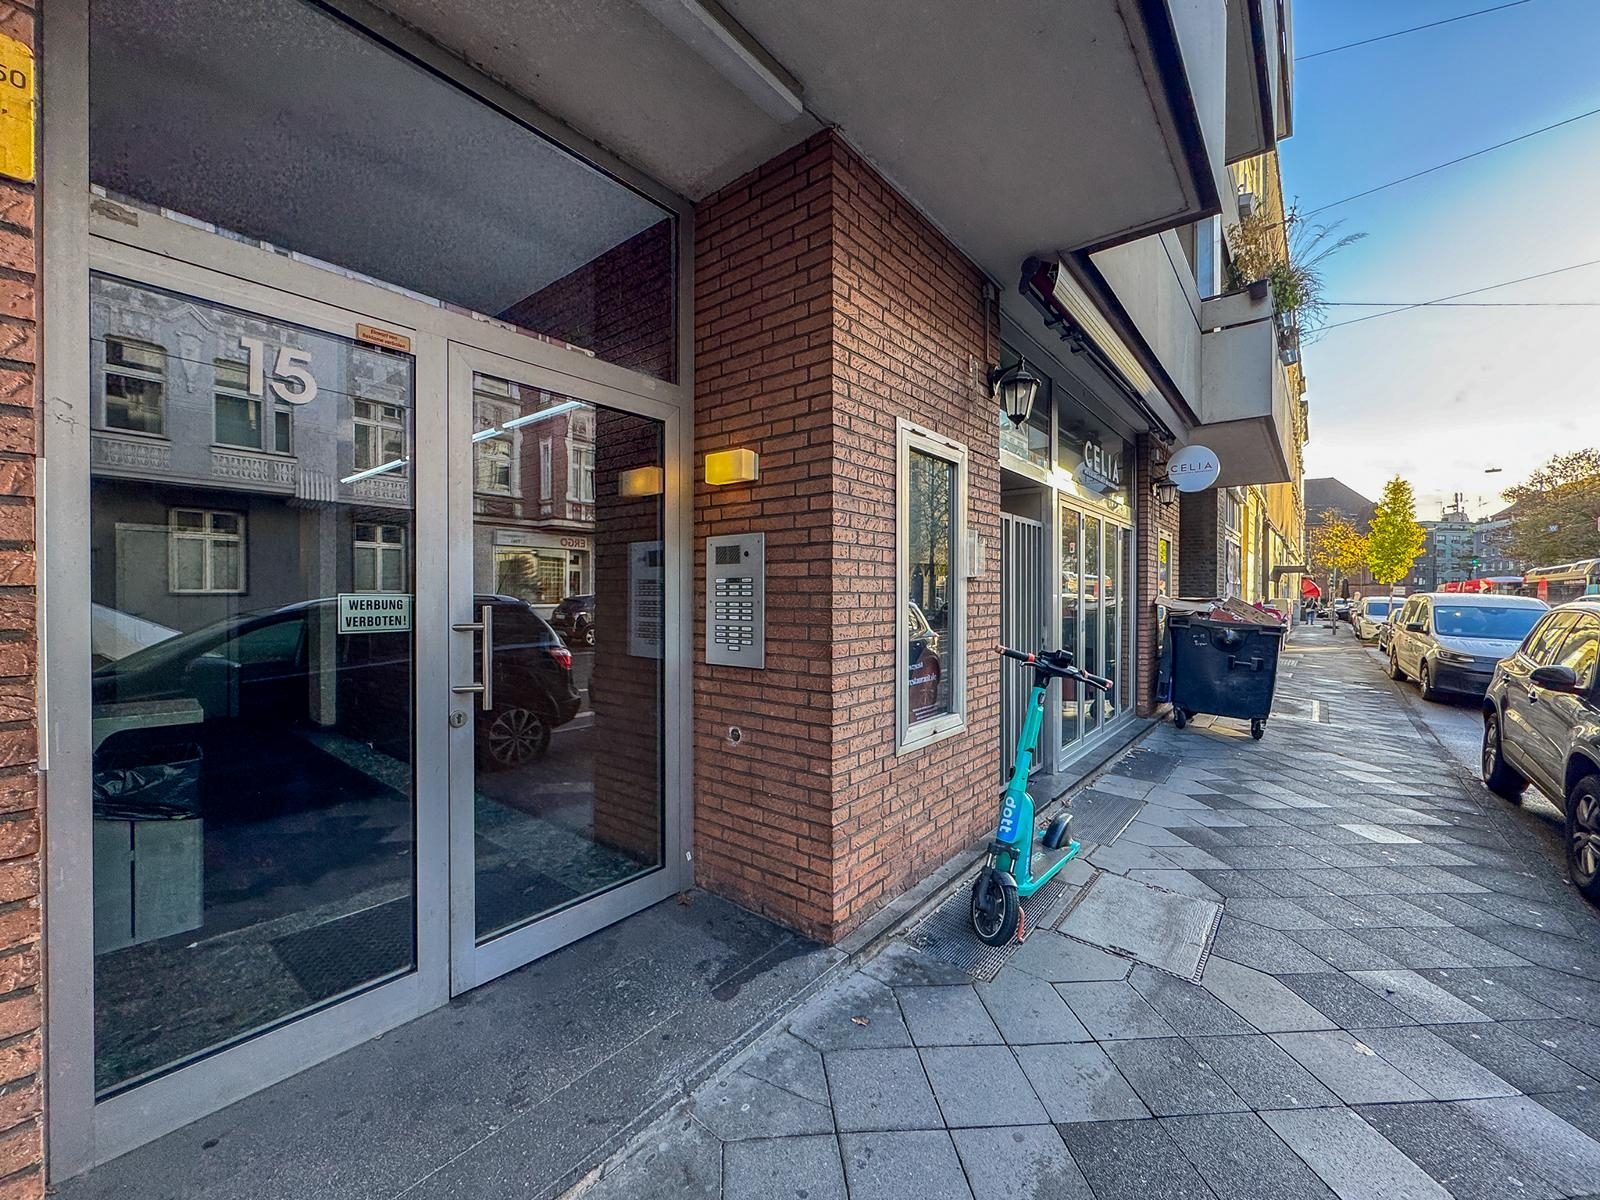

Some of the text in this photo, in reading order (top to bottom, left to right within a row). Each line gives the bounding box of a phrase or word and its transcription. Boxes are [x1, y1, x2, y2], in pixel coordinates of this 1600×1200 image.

[240, 336, 318, 405] 15
[1084, 440, 1120, 484] CELIA
[1170, 461, 1213, 473] CELIA
[348, 599, 404, 611] WERBUNG
[345, 615, 407, 628] VERBOTEN!
[999, 796, 1017, 833] dott
